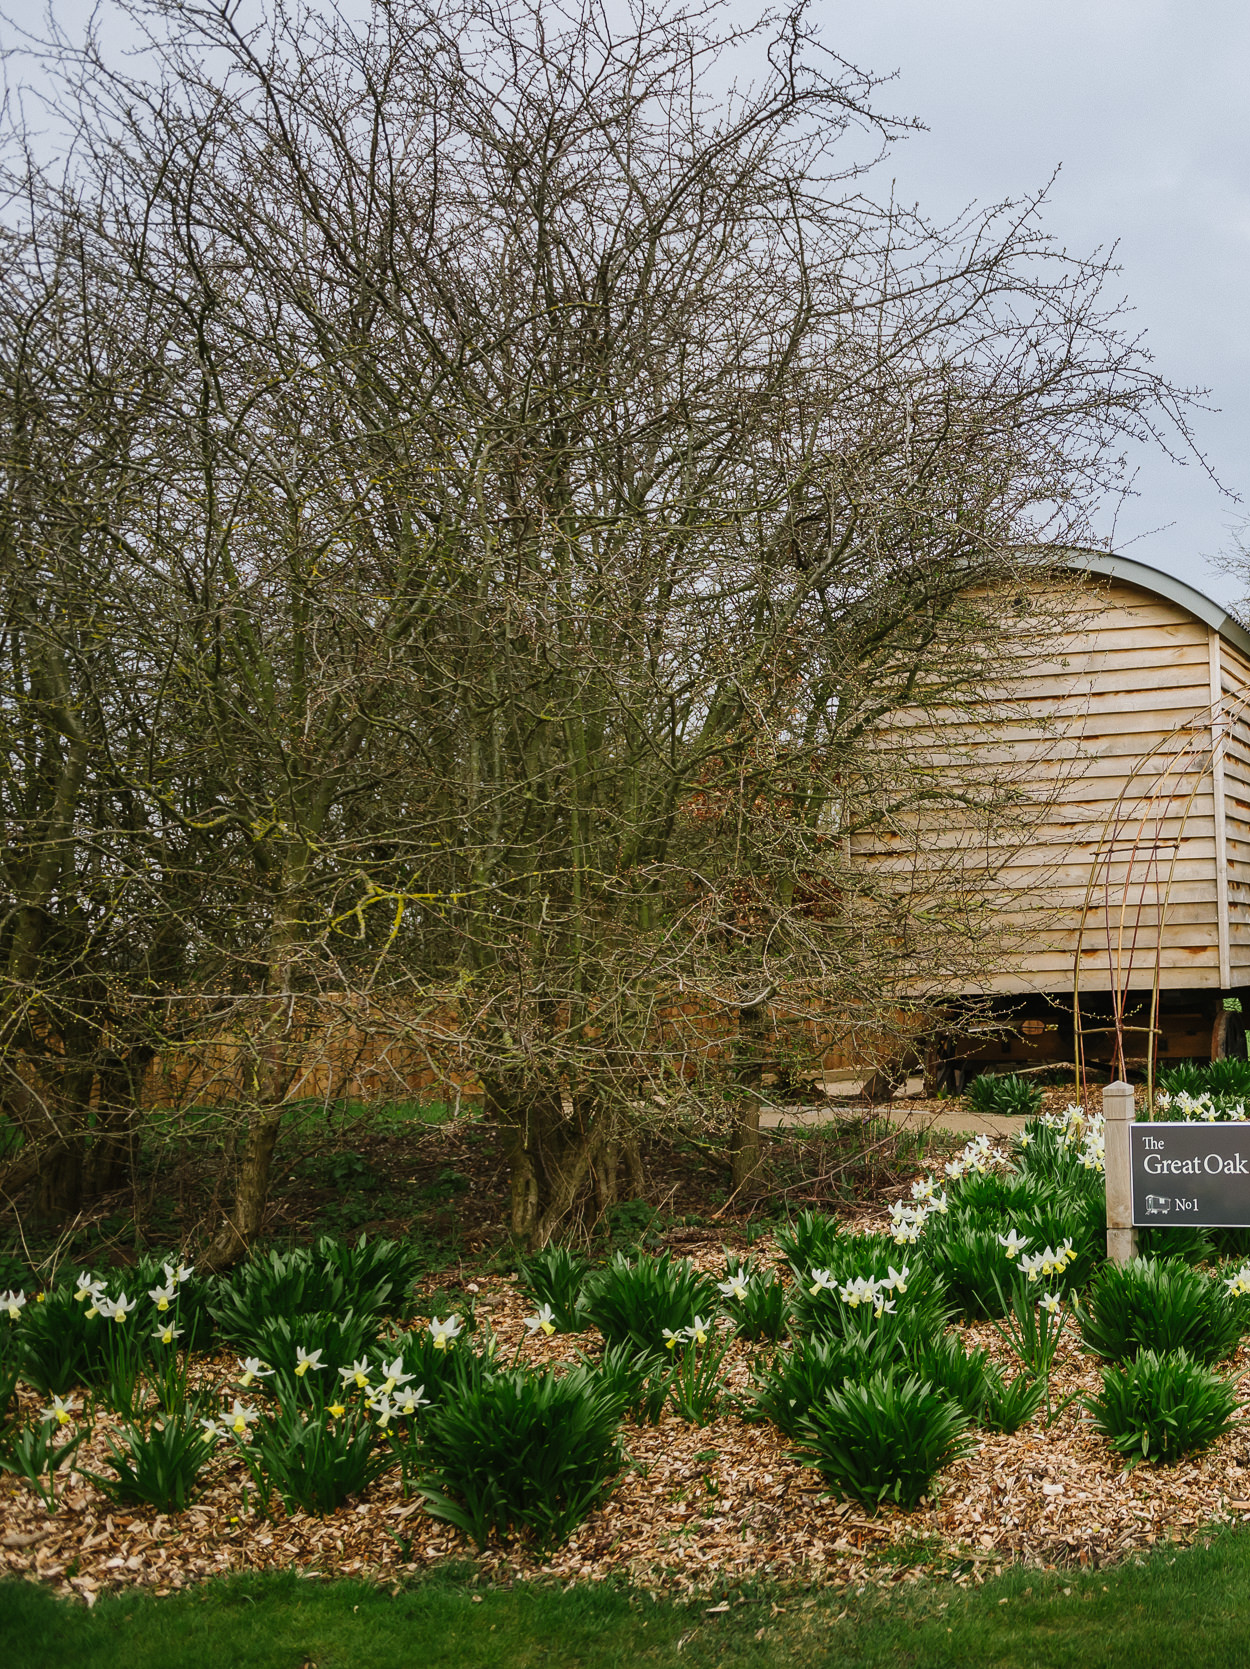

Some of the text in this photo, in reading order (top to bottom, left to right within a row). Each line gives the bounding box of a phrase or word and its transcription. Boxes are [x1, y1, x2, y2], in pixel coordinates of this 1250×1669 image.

[1142, 1136, 1165, 1150] The
[1143, 1153, 1249, 1174] Great Oak
